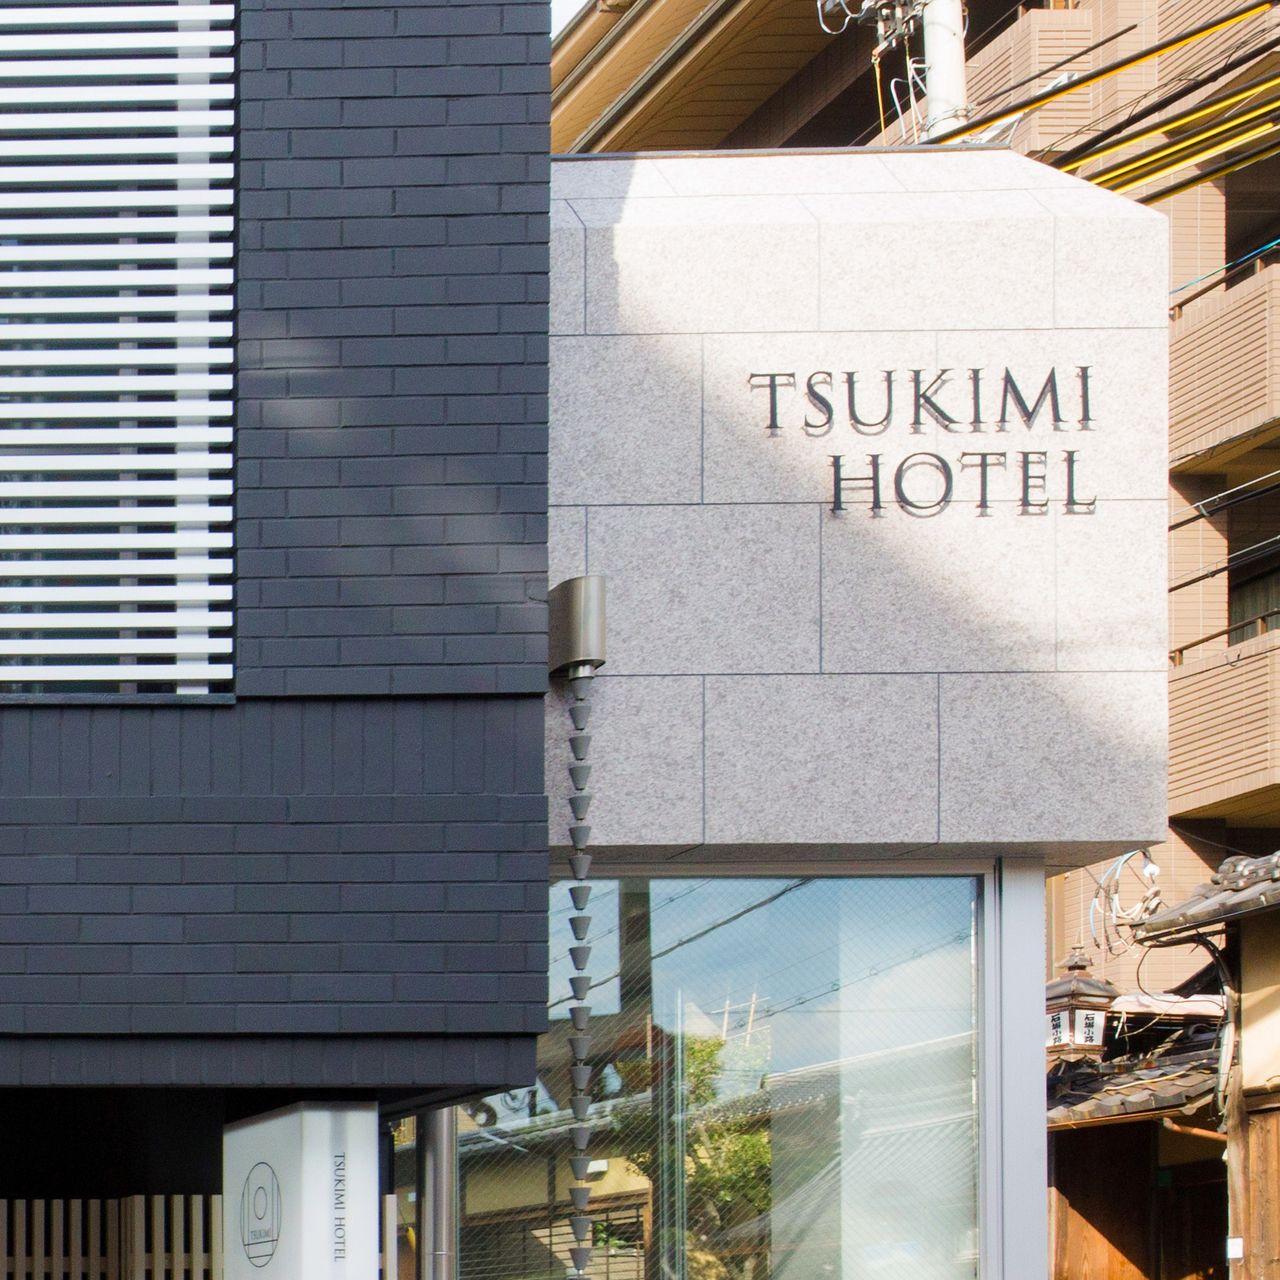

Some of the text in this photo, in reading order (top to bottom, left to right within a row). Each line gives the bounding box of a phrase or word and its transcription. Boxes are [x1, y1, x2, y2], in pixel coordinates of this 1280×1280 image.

[748, 366, 1094, 431] TSUKIMI
[827, 450, 1097, 512] HOTEL
[334, 1152, 346, 1262] TSUKIMI HOTEL
